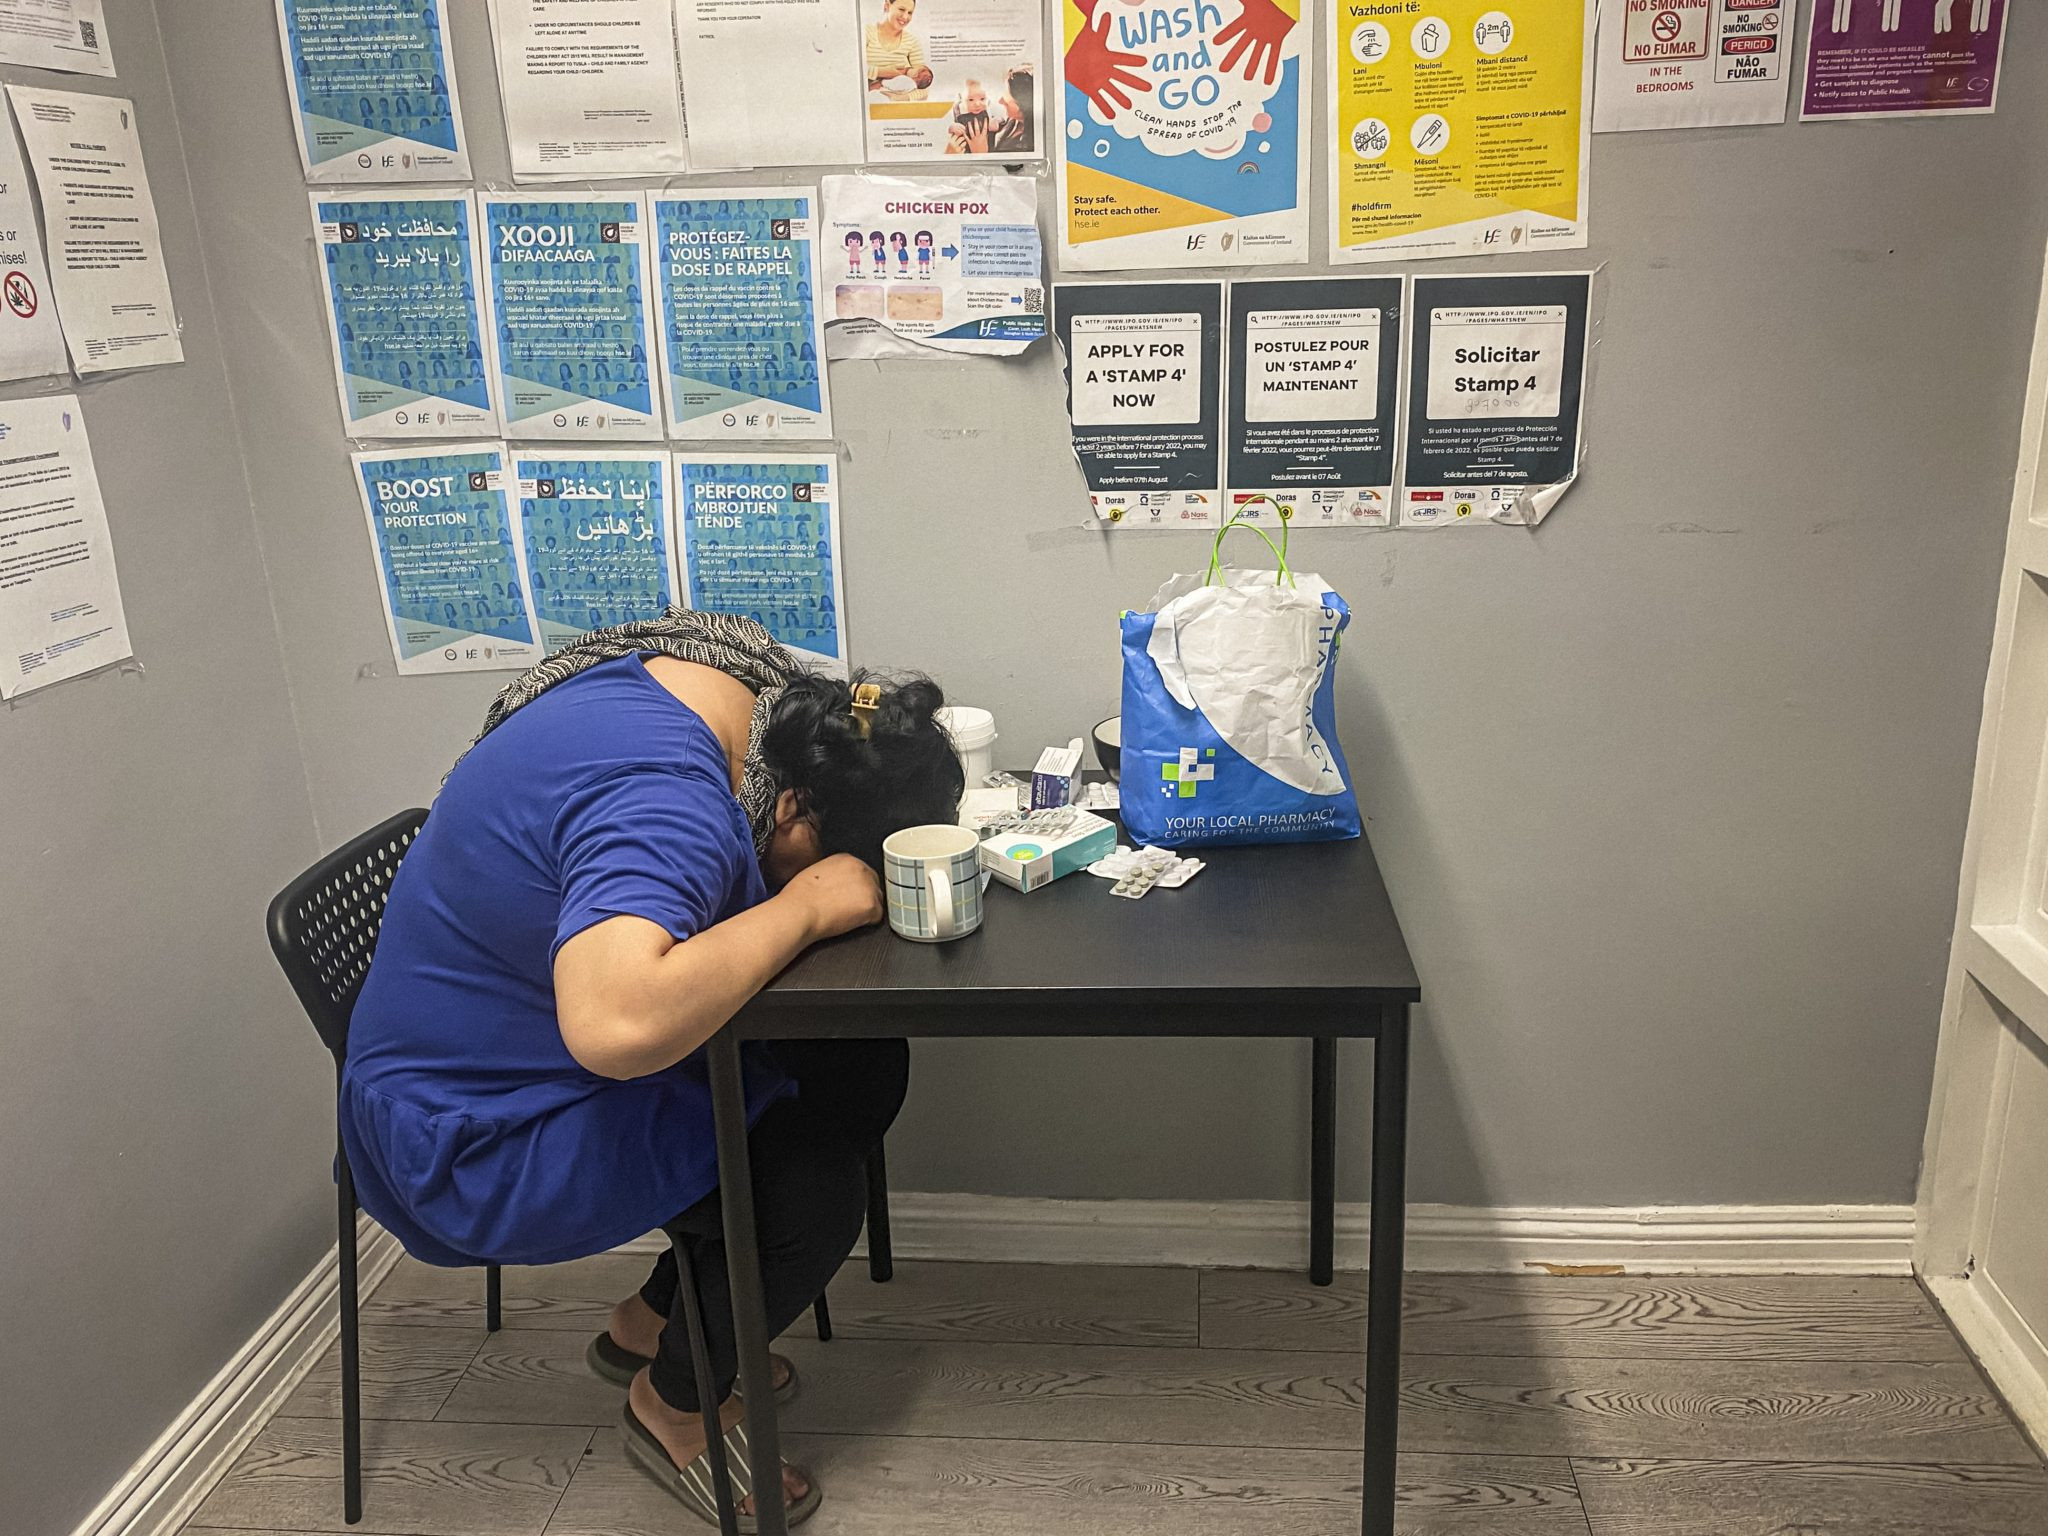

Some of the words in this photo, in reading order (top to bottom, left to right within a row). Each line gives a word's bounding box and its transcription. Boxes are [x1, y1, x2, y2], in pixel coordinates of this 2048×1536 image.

[1350, 3, 1402, 16] Vazhdoni
[1406, 2, 1420, 13] të:
[1630, 0, 1646, 12] NO
[1650, 0, 1706, 10] SMOKING
[1737, 15, 1750, 23] NO
[1723, 24, 1762, 33] SMOKING
[1634, 45, 1650, 56] NO
[1654, 42, 1696, 55] FUMAR
[1731, 40, 1768, 50] PERIGO
[1152, 40, 1212, 72] and
[1736, 56, 1759, 67] NÃO
[1922, 51, 1950, 59] cannot
[1415, 62, 1442, 70] Mbuloni
[1650, 68, 1660, 77] IN
[1664, 66, 1682, 76] THE
[1727, 68, 1767, 79] FUMAR
[1636, 81, 1694, 93] BEDROOMS
[1834, 80, 1859, 88] samples
[1870, 78, 1899, 86] diagnose
[1158, 74, 1220, 110] GO
[1134, 109, 1163, 124] CLEAN
[1166, 120, 1196, 128] HANDS
[1203, 112, 1224, 126] STOP
[1147, 128, 1182, 139] SPREAD
[1074, 195, 1094, 205] Stay
[1096, 195, 1117, 204] safe.
[885, 202, 954, 214] CHICKEN
[960, 203, 989, 215] POX
[1074, 207, 1108, 217] Protect
[1110, 206, 1131, 215] each
[1133, 206, 1161, 215] other.
[1351, 202, 1392, 212] #holdfirm
[397, 218, 457, 236] محافظت
[1074, 219, 1100, 229] hse.ie
[6, 231, 16, 240] or
[362, 222, 391, 242] خود
[500, 225, 574, 247] XOOJI
[669, 228, 750, 245] PROTÉGEZ-
[415, 246, 439, 266] بالا
[501, 249, 595, 263] DIFAACAAGA
[670, 248, 712, 260] VOUS
[722, 247, 769, 260] FAITES
[773, 247, 792, 259] LA
[671, 263, 711, 276] DOSE
[714, 263, 734, 276] DE
[737, 263, 792, 275] RAPPEL
[1088, 345, 1144, 358] APPLY
[1149, 344, 1184, 357] FOR
[1254, 341, 1326, 353] POSTULEZ
[1330, 340, 1369, 351] POUR
[1455, 346, 1540, 363] Solicitar
[1265, 362, 1285, 372] UN
[1086, 370, 1098, 383] A
[1102, 369, 1167, 383] 'STAMP
[1171, 369, 1186, 381] 4'
[1263, 380, 1358, 391] MAINTENANT
[1455, 377, 1519, 395] Stamp
[1524, 376, 1536, 390] 4
[1113, 394, 1155, 407] NOW
[1124, 452, 1138, 460] apply
[377, 477, 453, 500] BOOST
[559, 477, 612, 499] تحفظ
[620, 479, 650, 509] اپنا
[694, 481, 786, 499] PËRFORCO
[381, 501, 419, 514] YOUR
[695, 501, 778, 514] MBROJTJEN
[384, 512, 467, 529] PROTECTION
[696, 513, 743, 528] TËNDE
[1165, 816, 1204, 829] YOUR
[1210, 815, 1252, 828] LOCAL
[1259, 807, 1335, 826] PHARMACY
[1164, 830, 1208, 839] CARING
[1264, 820, 1335, 834] COMMUNITY
